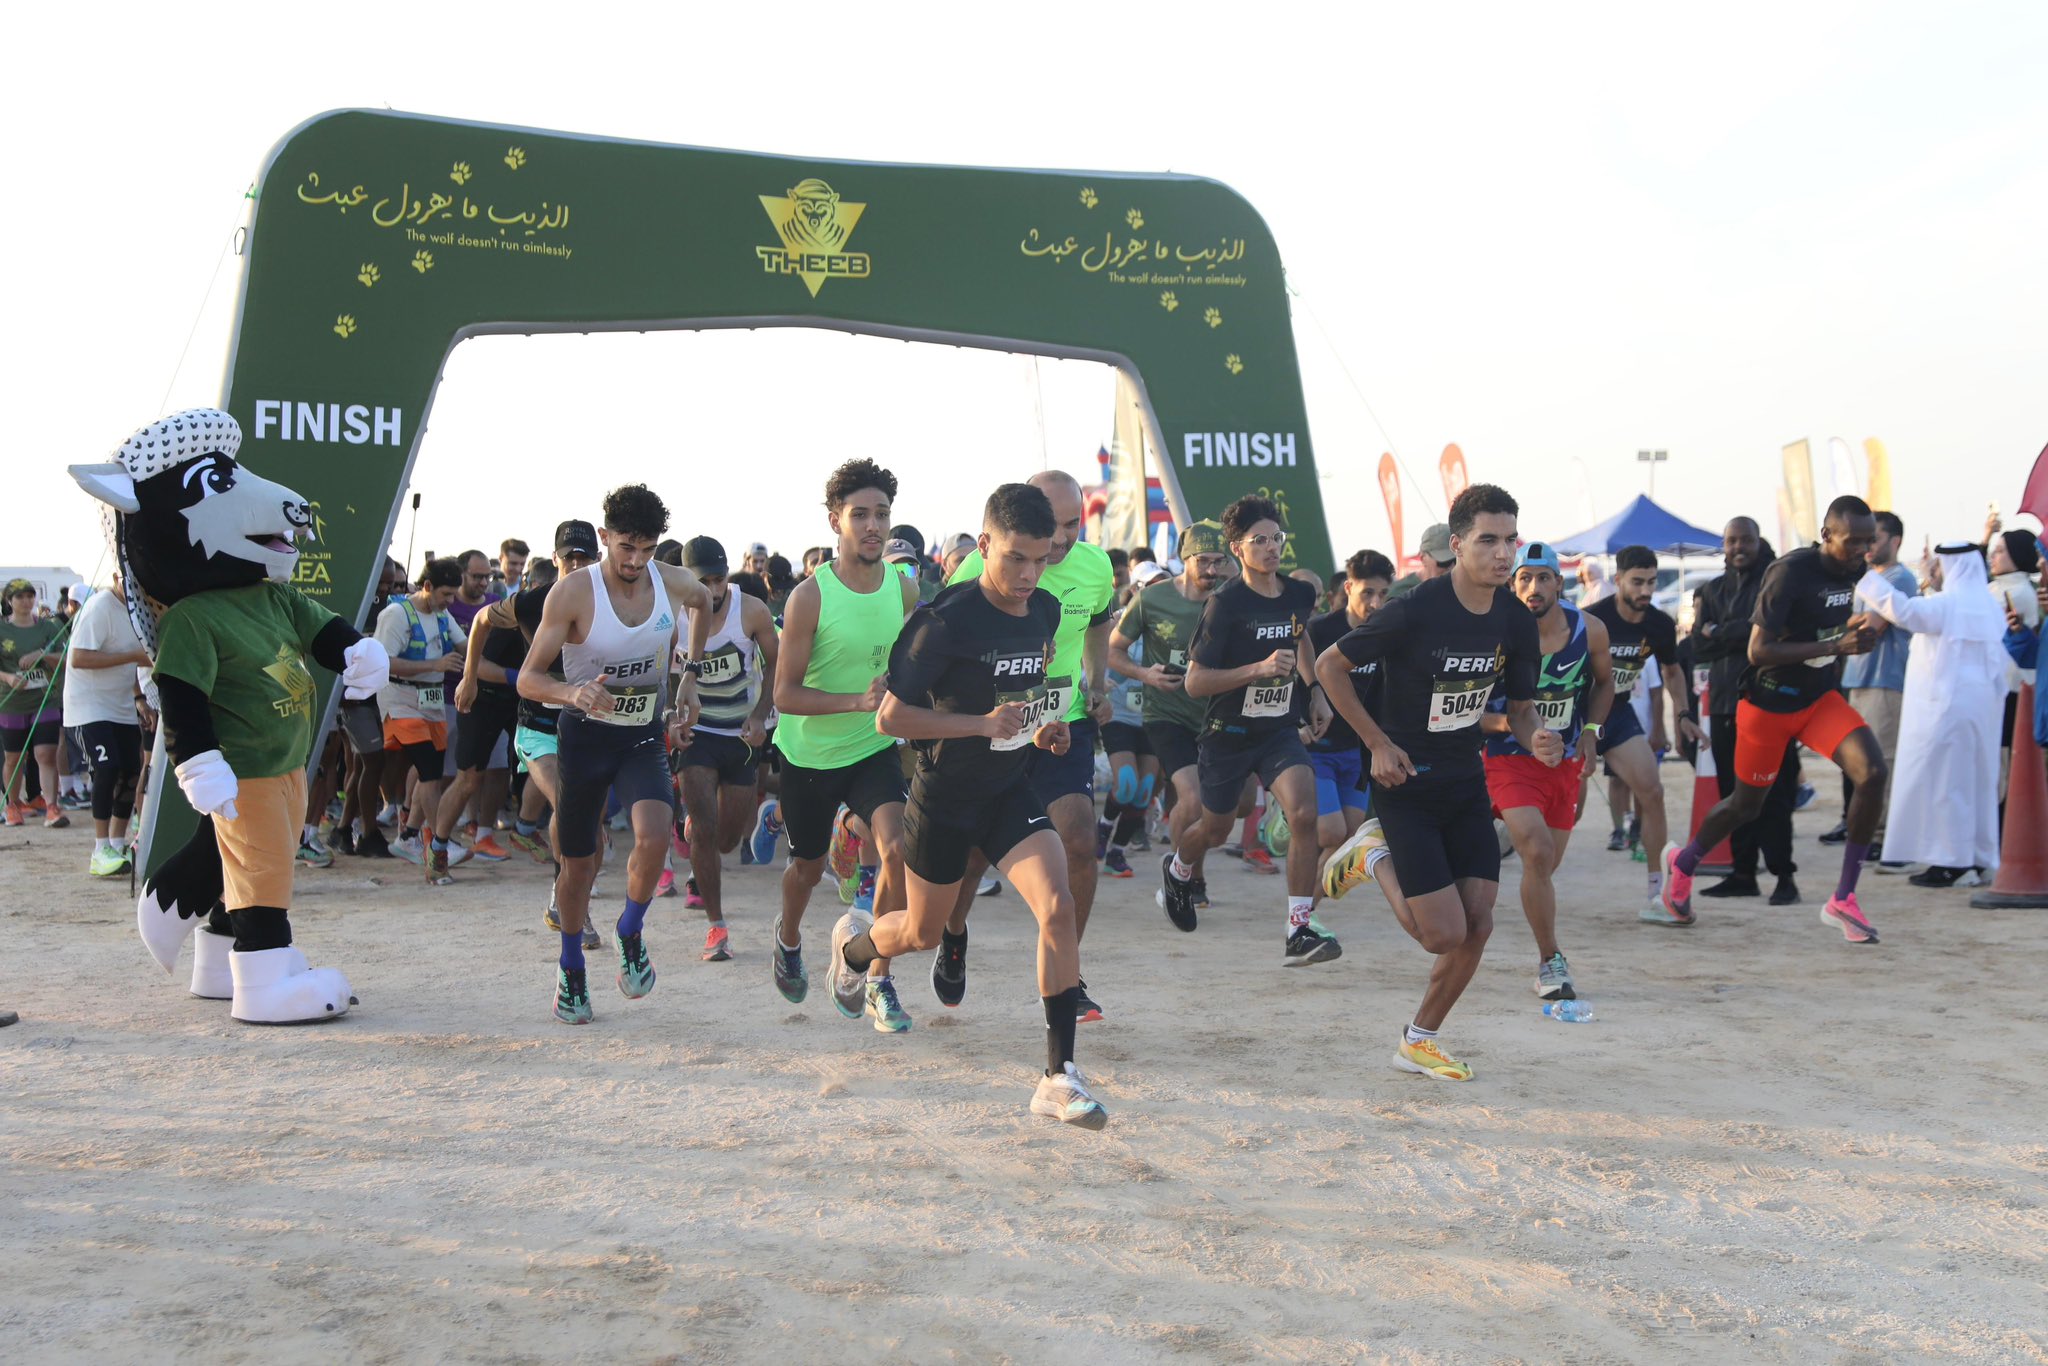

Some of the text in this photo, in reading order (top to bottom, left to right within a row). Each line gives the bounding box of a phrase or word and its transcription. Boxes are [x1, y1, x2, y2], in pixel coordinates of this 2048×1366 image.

[462, 197, 479, 219] ما
[488, 202, 570, 236] الذيب
[405, 228, 573, 260] The wolf doesn't run aimlessly
[1155, 239, 1169, 259] ما
[756, 246, 870, 278] THEEB
[1176, 237, 1246, 272] الذيب
[1108, 271, 1247, 288] The wolf doesn't run aimlessly
[255, 399, 402, 446] FINISH
[1184, 431, 1297, 468] FINISH
[1824, 591, 1852, 608] PERF
[1256, 624, 1292, 639] PERF
[602, 659, 655, 679] PERF
[702, 656, 730, 674] 974
[994, 656, 1043, 677] PERF
[1443, 656, 1495, 672] PERF
[614, 696, 648, 714] 083
[1253, 686, 1289, 706] 5040
[1442, 691, 1487, 716] 5042
[1022, 701, 1045, 728] 041
[1537, 701, 1567, 719] 007
[95, 744, 109, 762] 2
